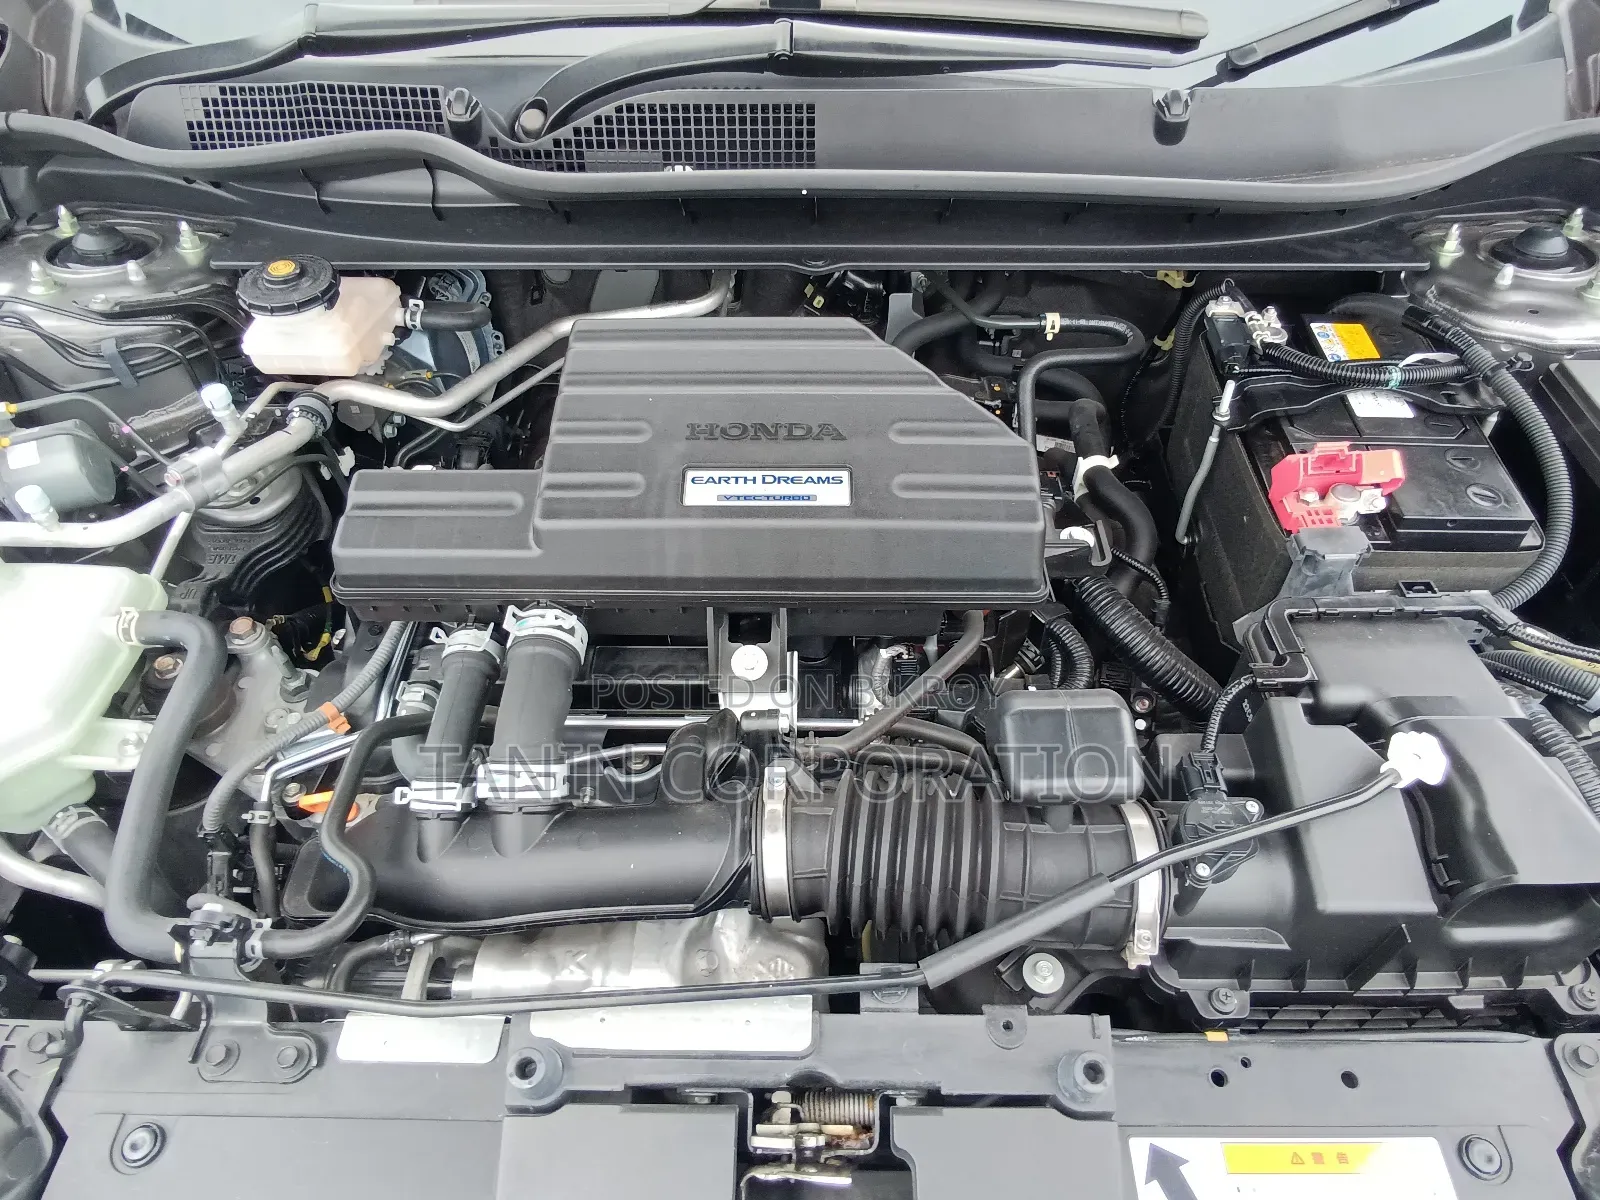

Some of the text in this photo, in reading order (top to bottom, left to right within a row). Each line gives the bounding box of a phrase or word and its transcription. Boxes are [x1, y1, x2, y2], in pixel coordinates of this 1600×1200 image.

[684, 422, 848, 441] HONDA
[690, 474, 844, 485] EARTH DREAMS
